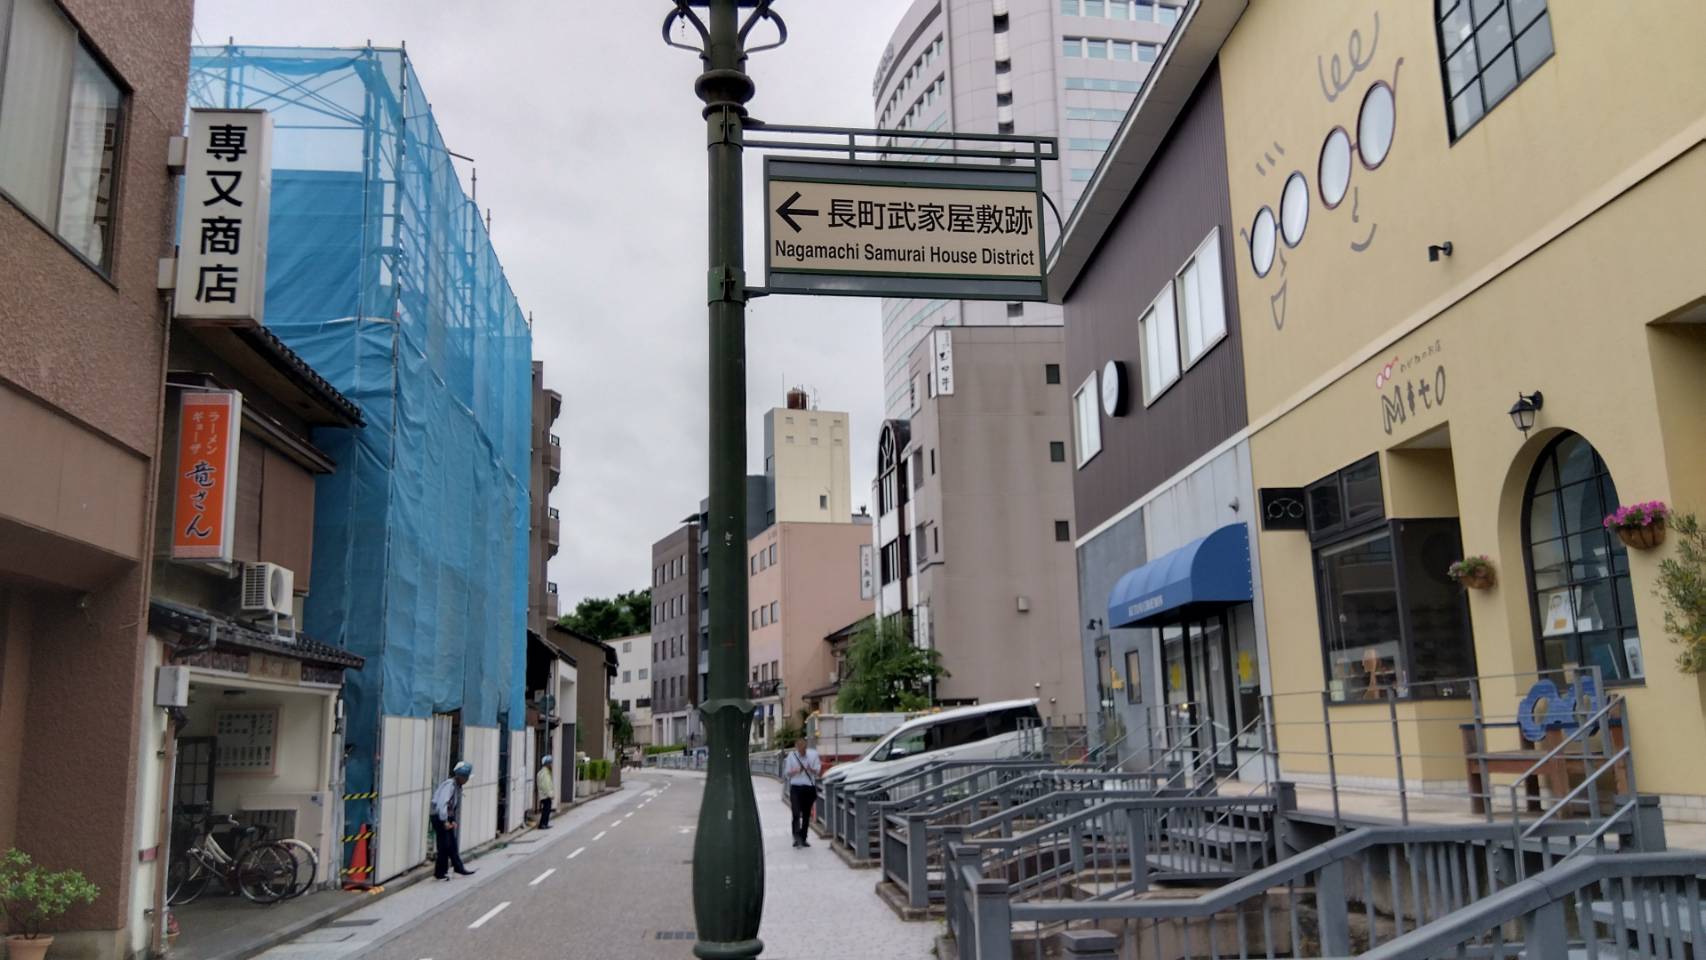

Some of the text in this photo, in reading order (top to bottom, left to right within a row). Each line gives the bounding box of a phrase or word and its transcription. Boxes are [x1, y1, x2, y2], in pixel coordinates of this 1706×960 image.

[195, 124, 248, 304] 専又商店
[828, 199, 1033, 235] 長町武家屋敷跡
[775, 240, 1035, 265] Nagamachi Samurai House District
[190, 411, 204, 455] ギョーザ
[207, 412, 220, 455] ラーメン
[185, 461, 216, 538] 竜さん
